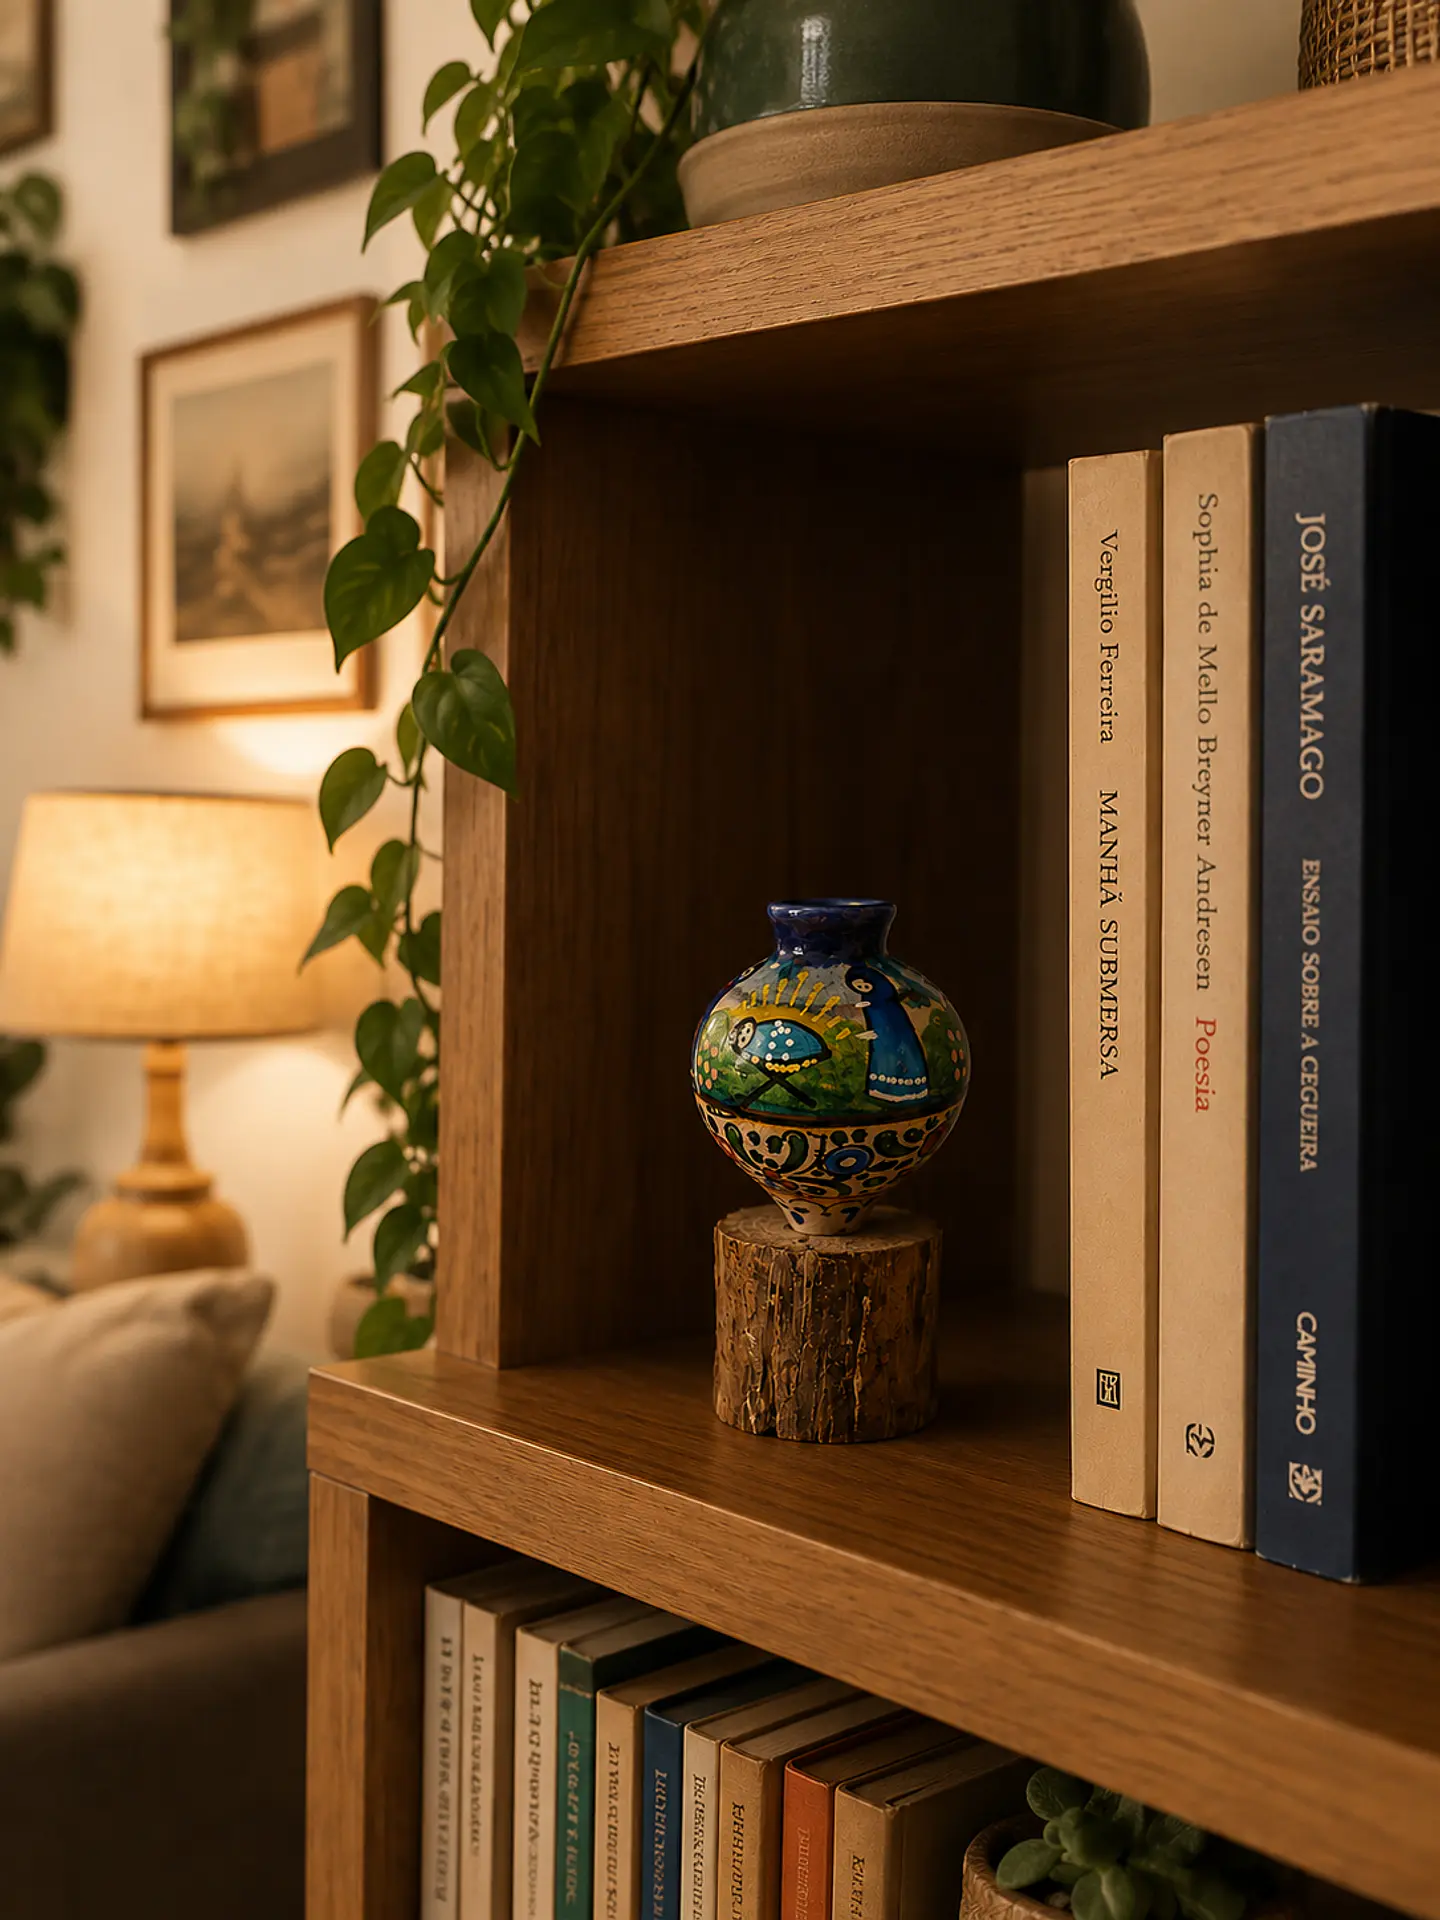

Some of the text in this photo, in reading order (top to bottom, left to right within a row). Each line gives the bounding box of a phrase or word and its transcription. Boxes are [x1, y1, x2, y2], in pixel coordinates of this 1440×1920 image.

[1093, 528, 1120, 745] Vergilio Ferreira
[1191, 493, 1219, 991] Sophia de Mello Breyner Andresen
[1295, 512, 1332, 800] JOSÉ SARAMAGO
[1099, 918, 1120, 1081] SUBMERSA
[1194, 1016, 1217, 1113] Poesia
[1299, 858, 1321, 1173] ENSAIO SOBRE A CEGUEIRA
[1295, 1311, 1318, 1436] CAMINHO
